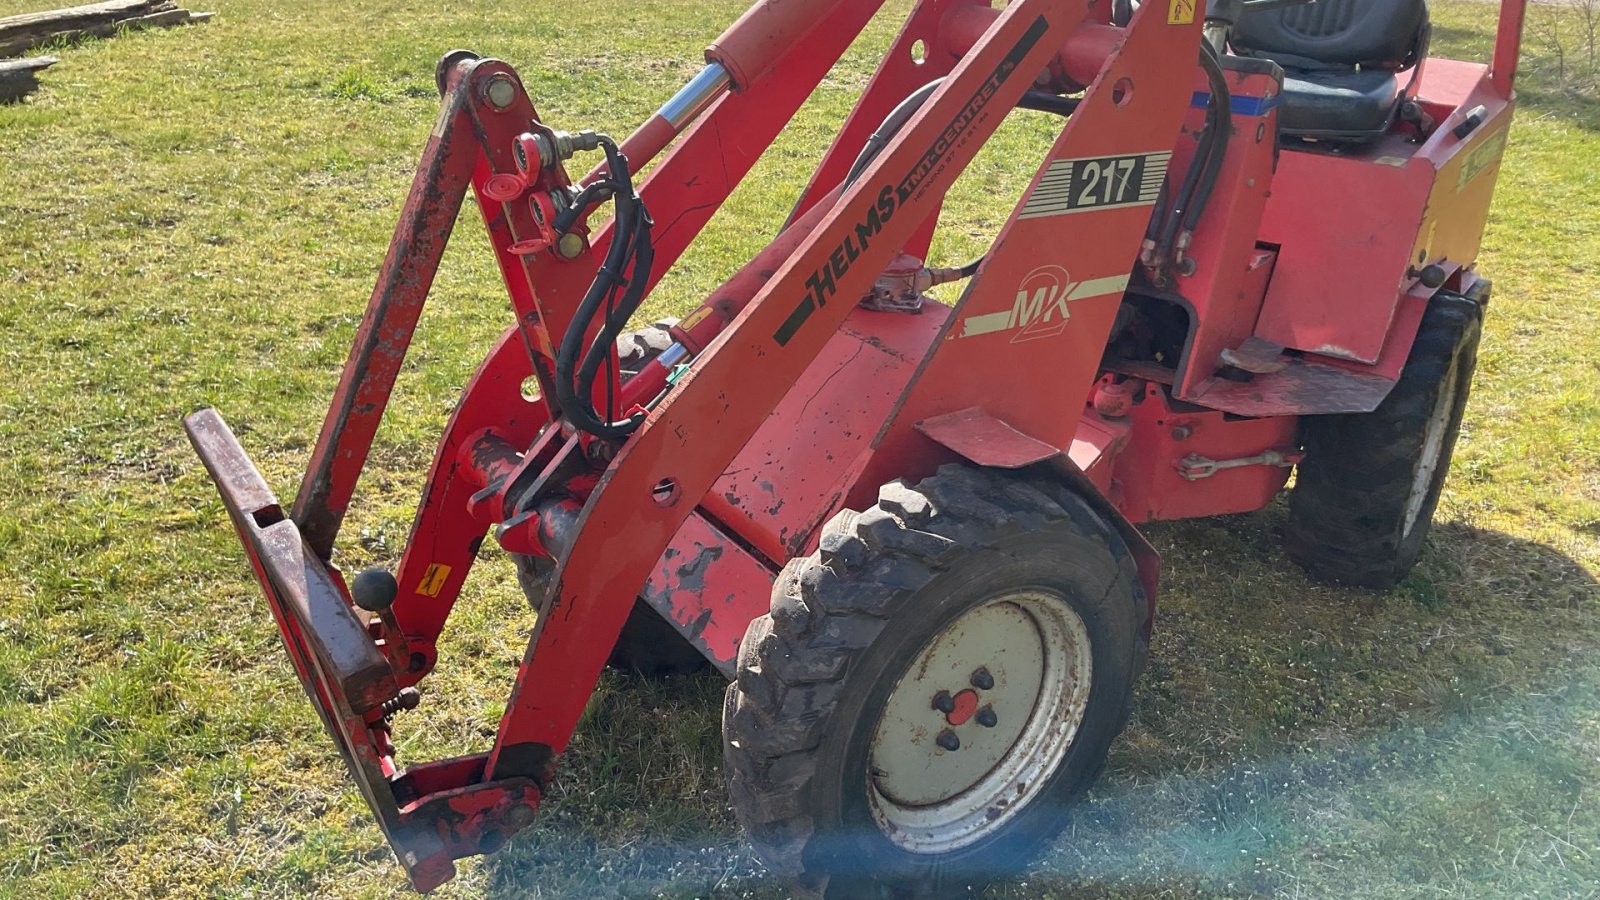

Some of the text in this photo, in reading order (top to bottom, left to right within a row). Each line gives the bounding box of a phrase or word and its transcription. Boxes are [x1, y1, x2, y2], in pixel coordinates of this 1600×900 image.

[805, 185, 895, 308] HELMS
[902, 73, 1000, 193] TMT-CENTRET
[1077, 158, 1137, 206] 217
[1008, 281, 1080, 328] MK
